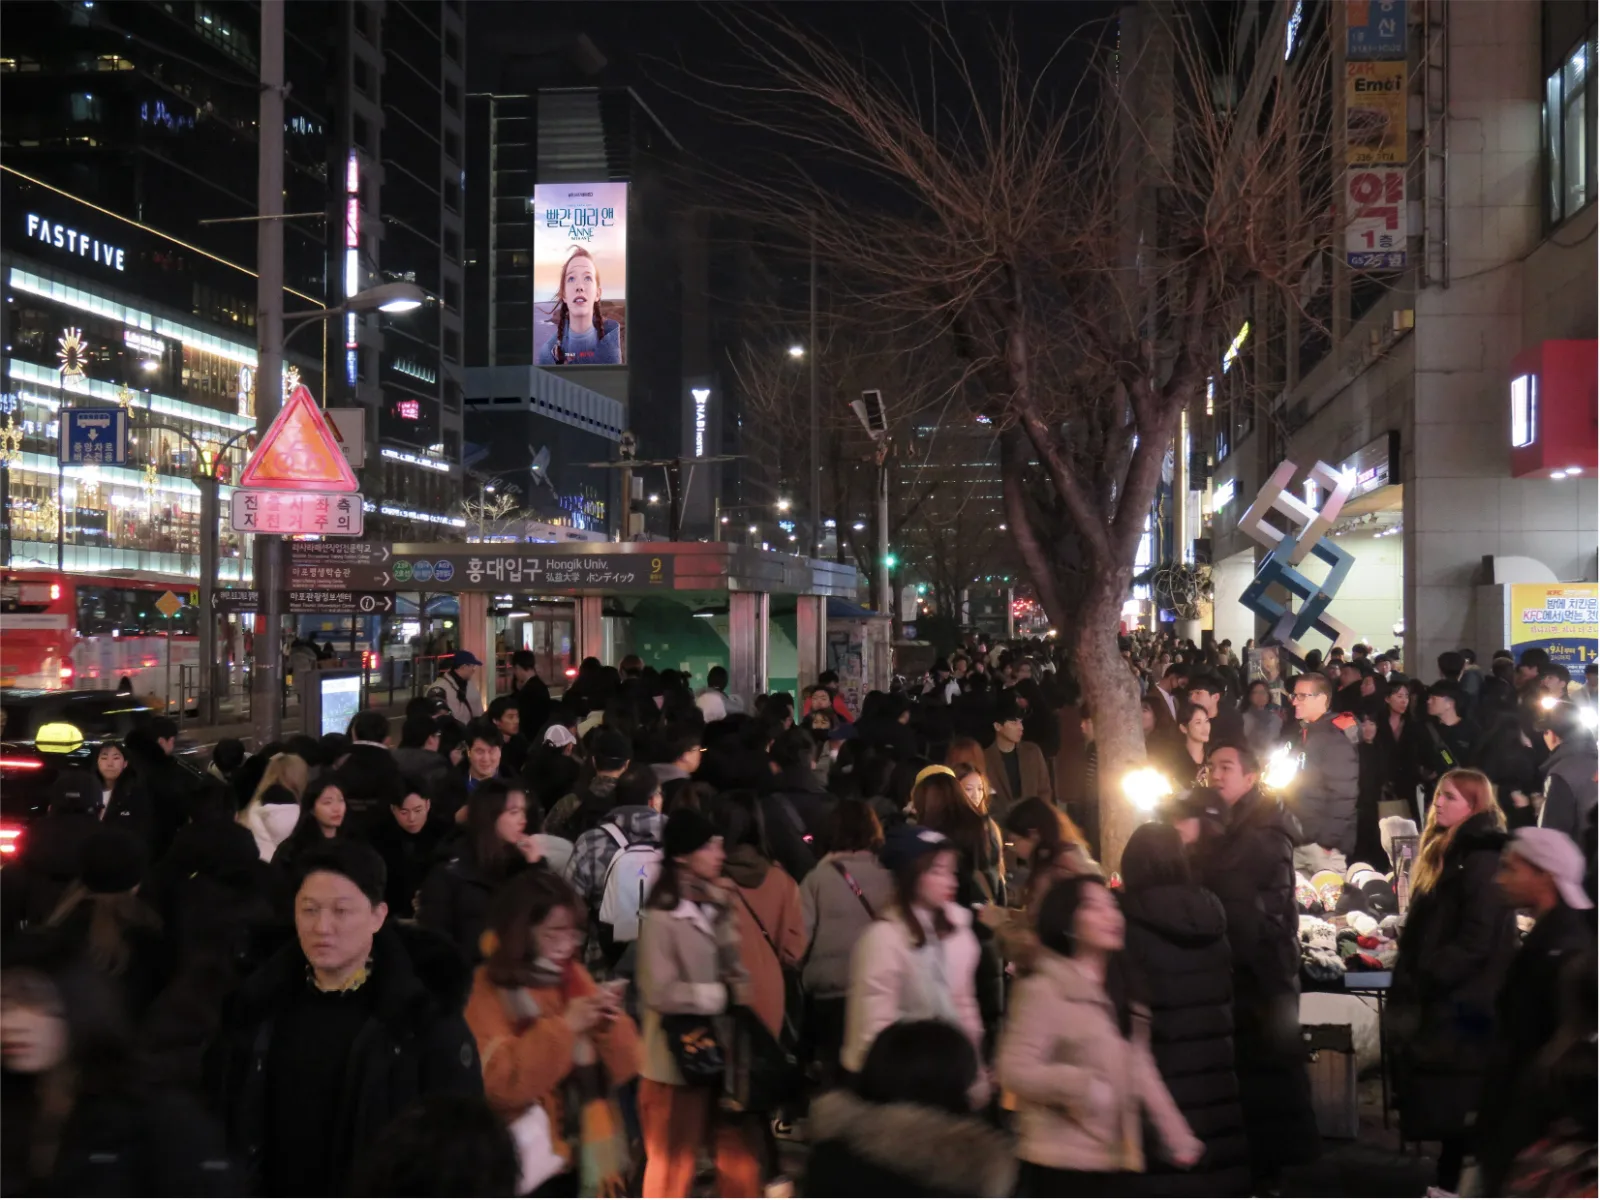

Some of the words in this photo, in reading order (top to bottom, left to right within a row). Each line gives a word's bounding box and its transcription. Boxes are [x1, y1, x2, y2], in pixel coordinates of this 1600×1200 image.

[1349, 172, 1404, 230] 약
[546, 208, 572, 228] 빨간
[574, 208, 599, 228] 머리
[601, 207, 615, 227] 앤
[568, 224, 595, 237] ANNE
[27, 213, 125, 272] FASTFIVE
[696, 404, 706, 431] NABI
[316, 496, 351, 513] 좌측
[244, 512, 304, 529] 자전거
[314, 515, 351, 531] 주의
[466, 557, 543, 583] 홍대입구
[546, 558, 583, 571] Hongik
[584, 558, 609, 570] Univ.
[651, 557, 662, 573] 9
[289, 591, 353, 602] 마포관광정보센터
[1547, 598, 1566, 610] 밤에
[1523, 610, 1562, 621] KFC에서
[1564, 610, 1584, 621] 먹는
